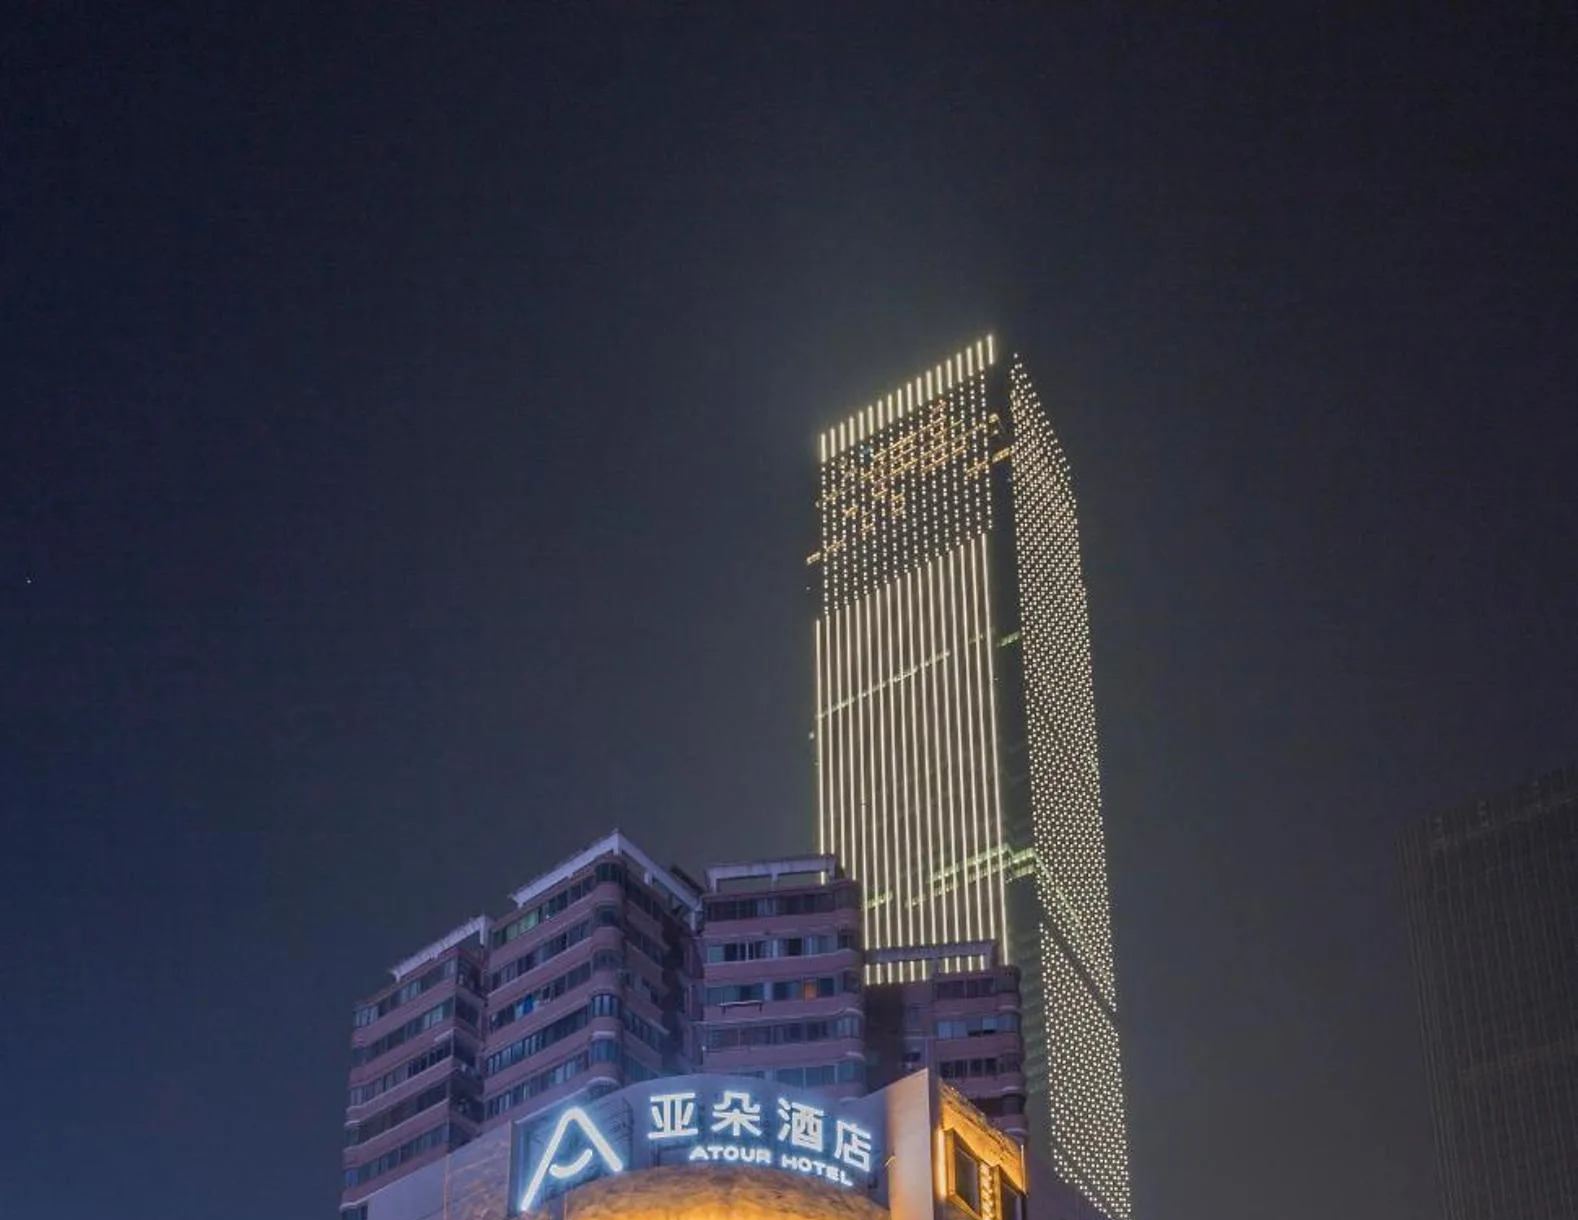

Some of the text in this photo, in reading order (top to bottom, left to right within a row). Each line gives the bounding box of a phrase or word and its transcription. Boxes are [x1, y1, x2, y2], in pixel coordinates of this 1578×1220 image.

[647, 1090, 873, 1173] 亚朵酒店
[689, 1144, 854, 1187] ATOUR HOTEL
